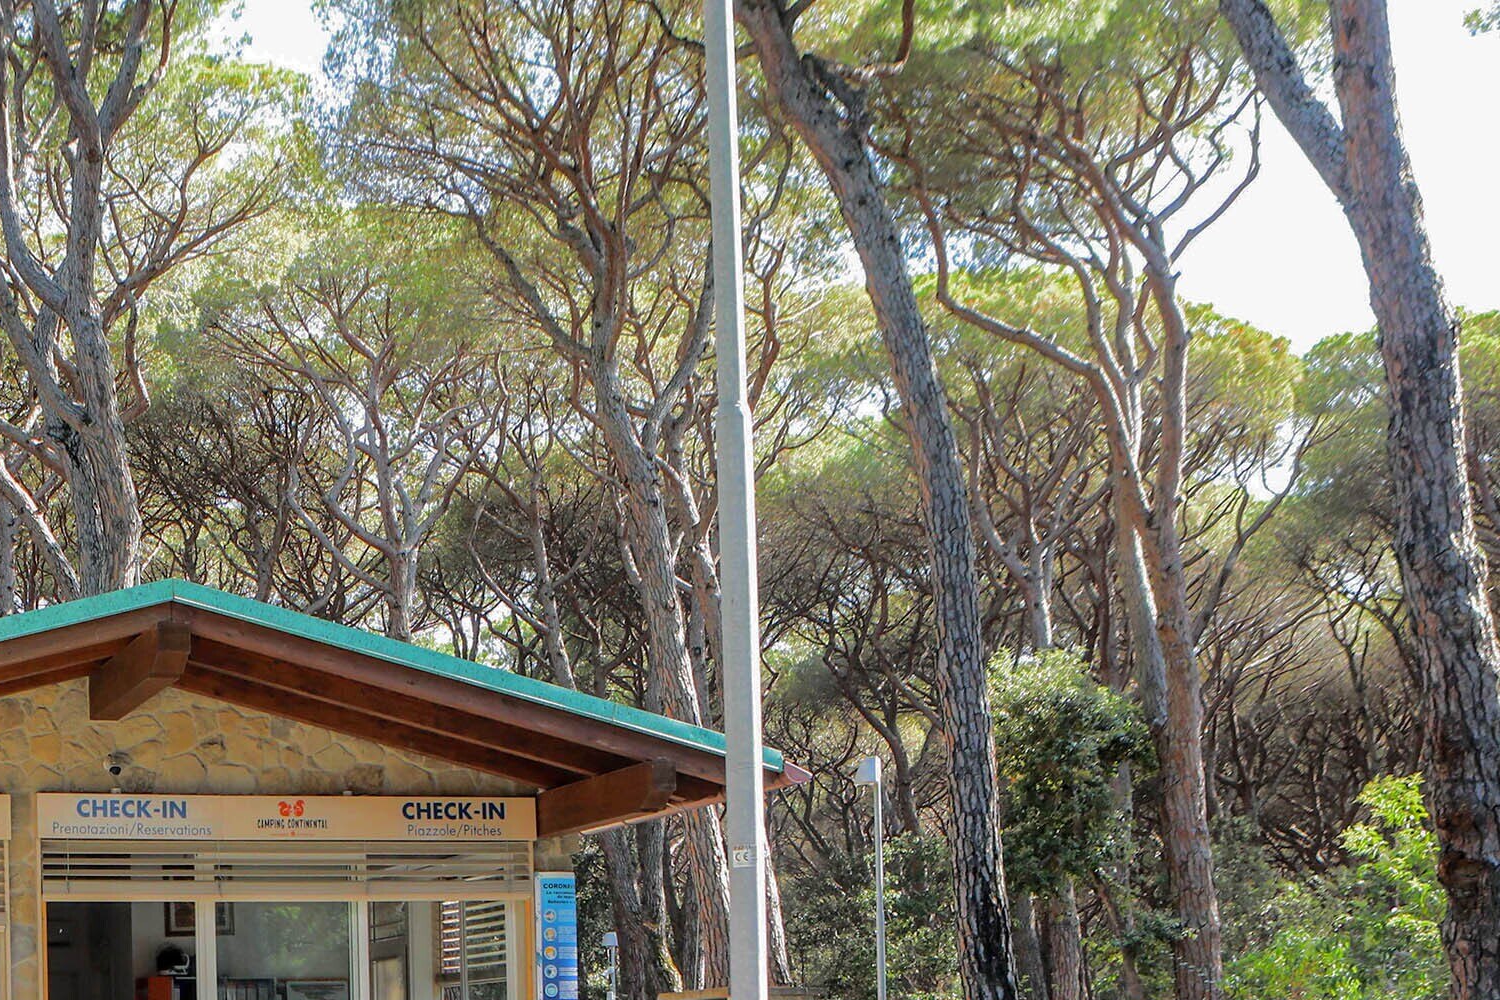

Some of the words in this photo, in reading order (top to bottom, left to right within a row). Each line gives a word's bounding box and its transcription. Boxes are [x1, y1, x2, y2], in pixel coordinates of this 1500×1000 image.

[76, 799, 187, 819] CHECK-IN
[401, 802, 506, 820] CHECK-IN
[52, 821, 212, 837] Prenotazioni/Reservations
[257, 819, 285, 830] CAMPING
[287, 818, 328, 830] CONTINENTAL
[407, 824, 502, 837] Piazzole/Pitches
